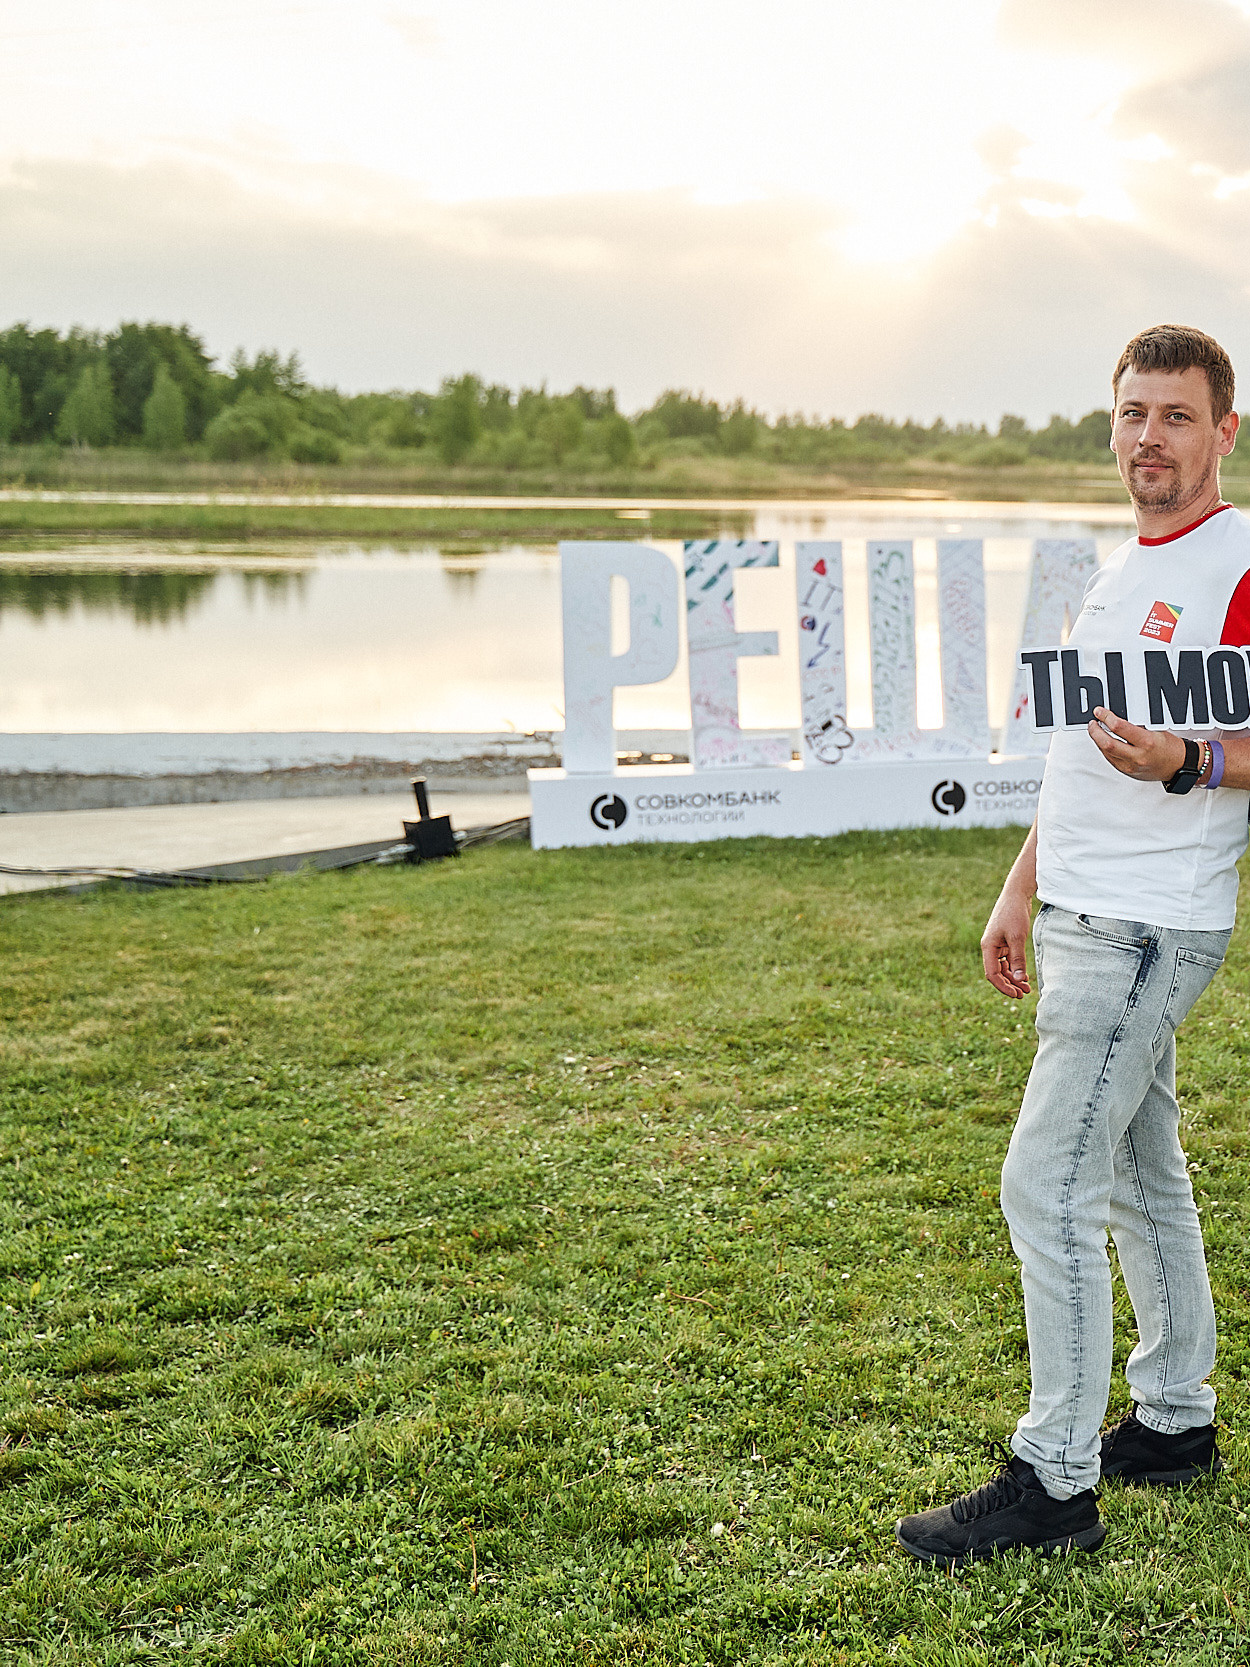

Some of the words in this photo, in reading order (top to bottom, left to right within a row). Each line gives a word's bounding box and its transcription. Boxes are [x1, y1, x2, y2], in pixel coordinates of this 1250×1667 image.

[1145, 622, 1162, 631] FEST
[1148, 618, 1174, 628] SUMMER
[1143, 627, 1161, 636] 2023
[1021, 649, 1129, 727] ТЫ
[974, 780, 1042, 796] СОВКО
[635, 790, 782, 811] СОВКОМБАНК
[975, 798, 1039, 812] ТЕХНОЛ
[637, 811, 746, 826] ТЕХНОЛОГИИ
